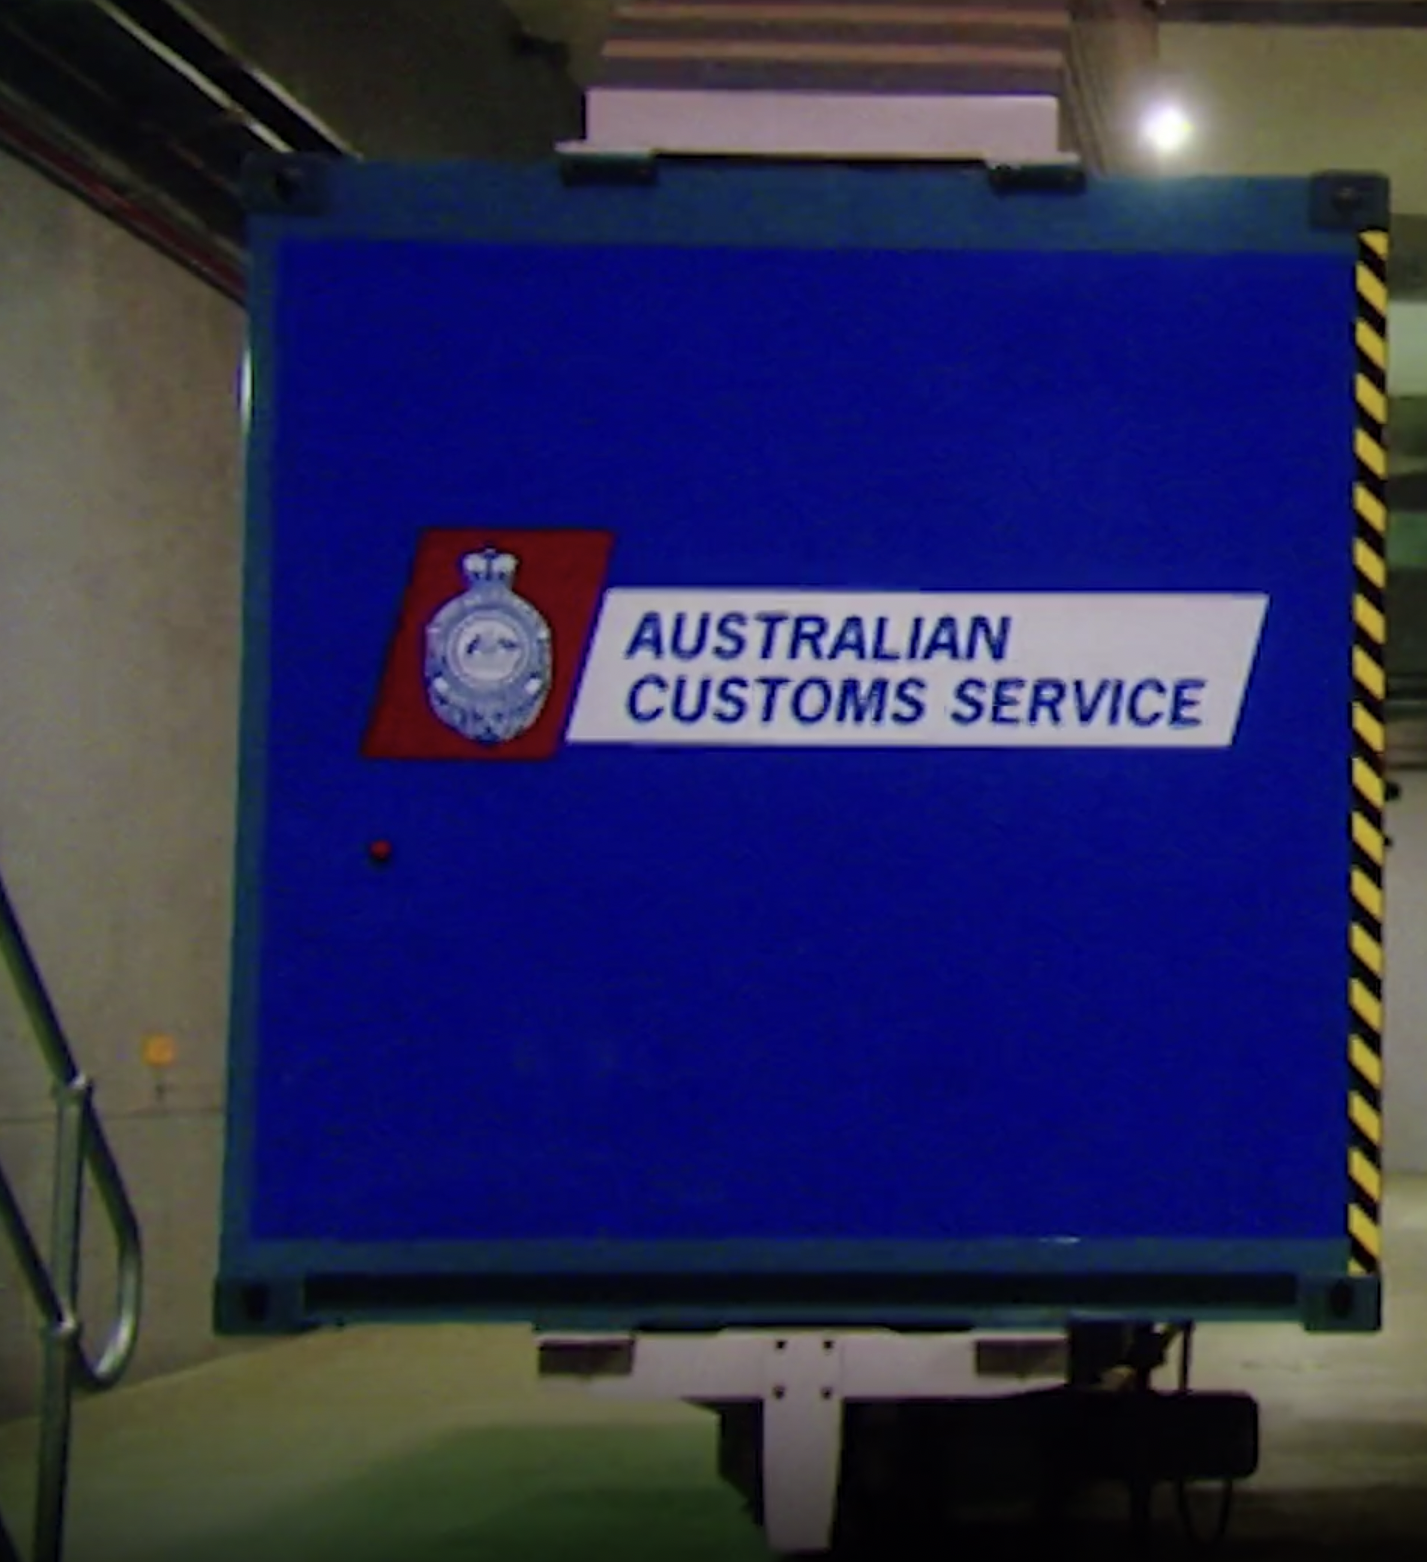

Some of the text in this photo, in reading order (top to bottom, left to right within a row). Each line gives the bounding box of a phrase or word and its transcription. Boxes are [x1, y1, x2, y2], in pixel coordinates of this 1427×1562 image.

[625, 612, 1011, 663] AUSTRALIAN
[626, 674, 1206, 729] CUSTOMS SERVICE
